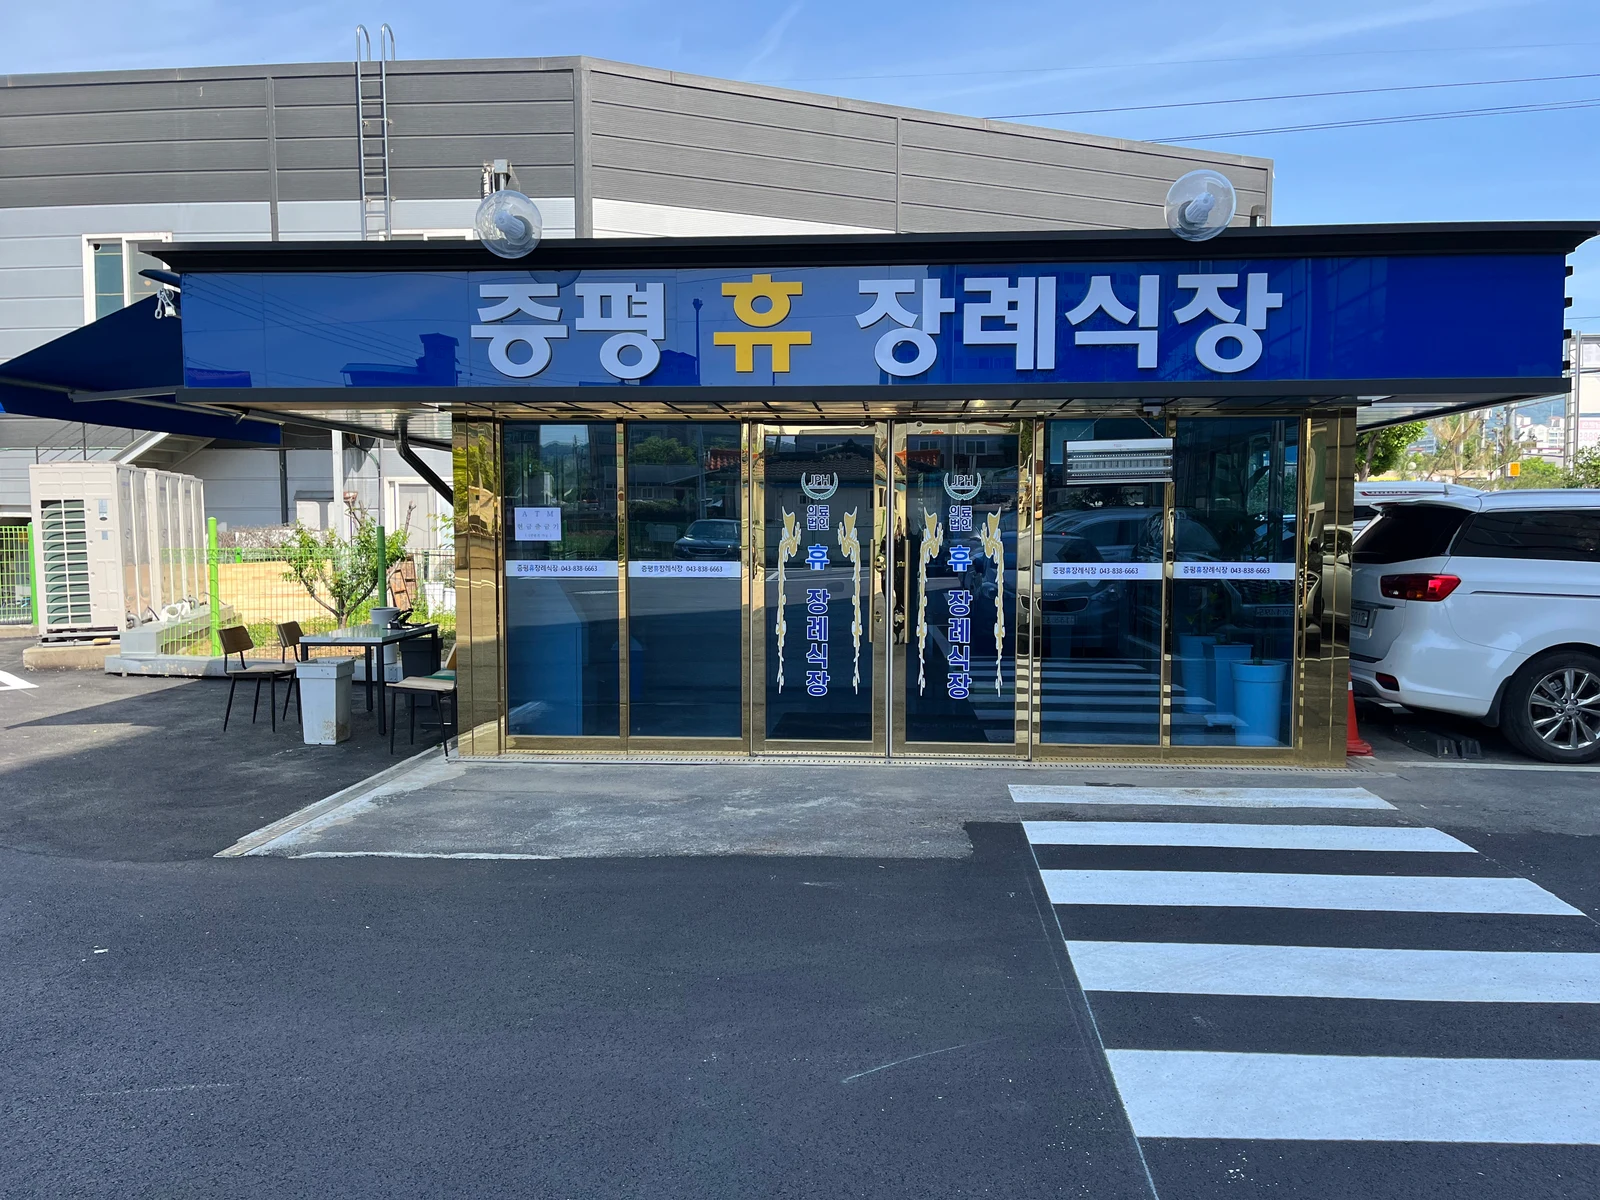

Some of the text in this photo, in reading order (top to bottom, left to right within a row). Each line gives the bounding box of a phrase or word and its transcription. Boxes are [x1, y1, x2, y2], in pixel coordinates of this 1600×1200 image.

[471, 272, 1283, 380] 증평 휴 장례식장
[808, 474, 830, 486] JPH
[951, 475, 974, 486] JPH
[807, 505, 830, 517] 의료
[949, 505, 973, 518] 의료
[807, 517, 830, 531] 법인
[949, 517, 973, 531] 법인
[685, 565, 723, 573] 043-838-6663
[1099, 567, 1139, 575] 043-838-6663
[805, 543, 831, 697] 휴 장례식장
[947, 545, 973, 699] 휴 장례식장
